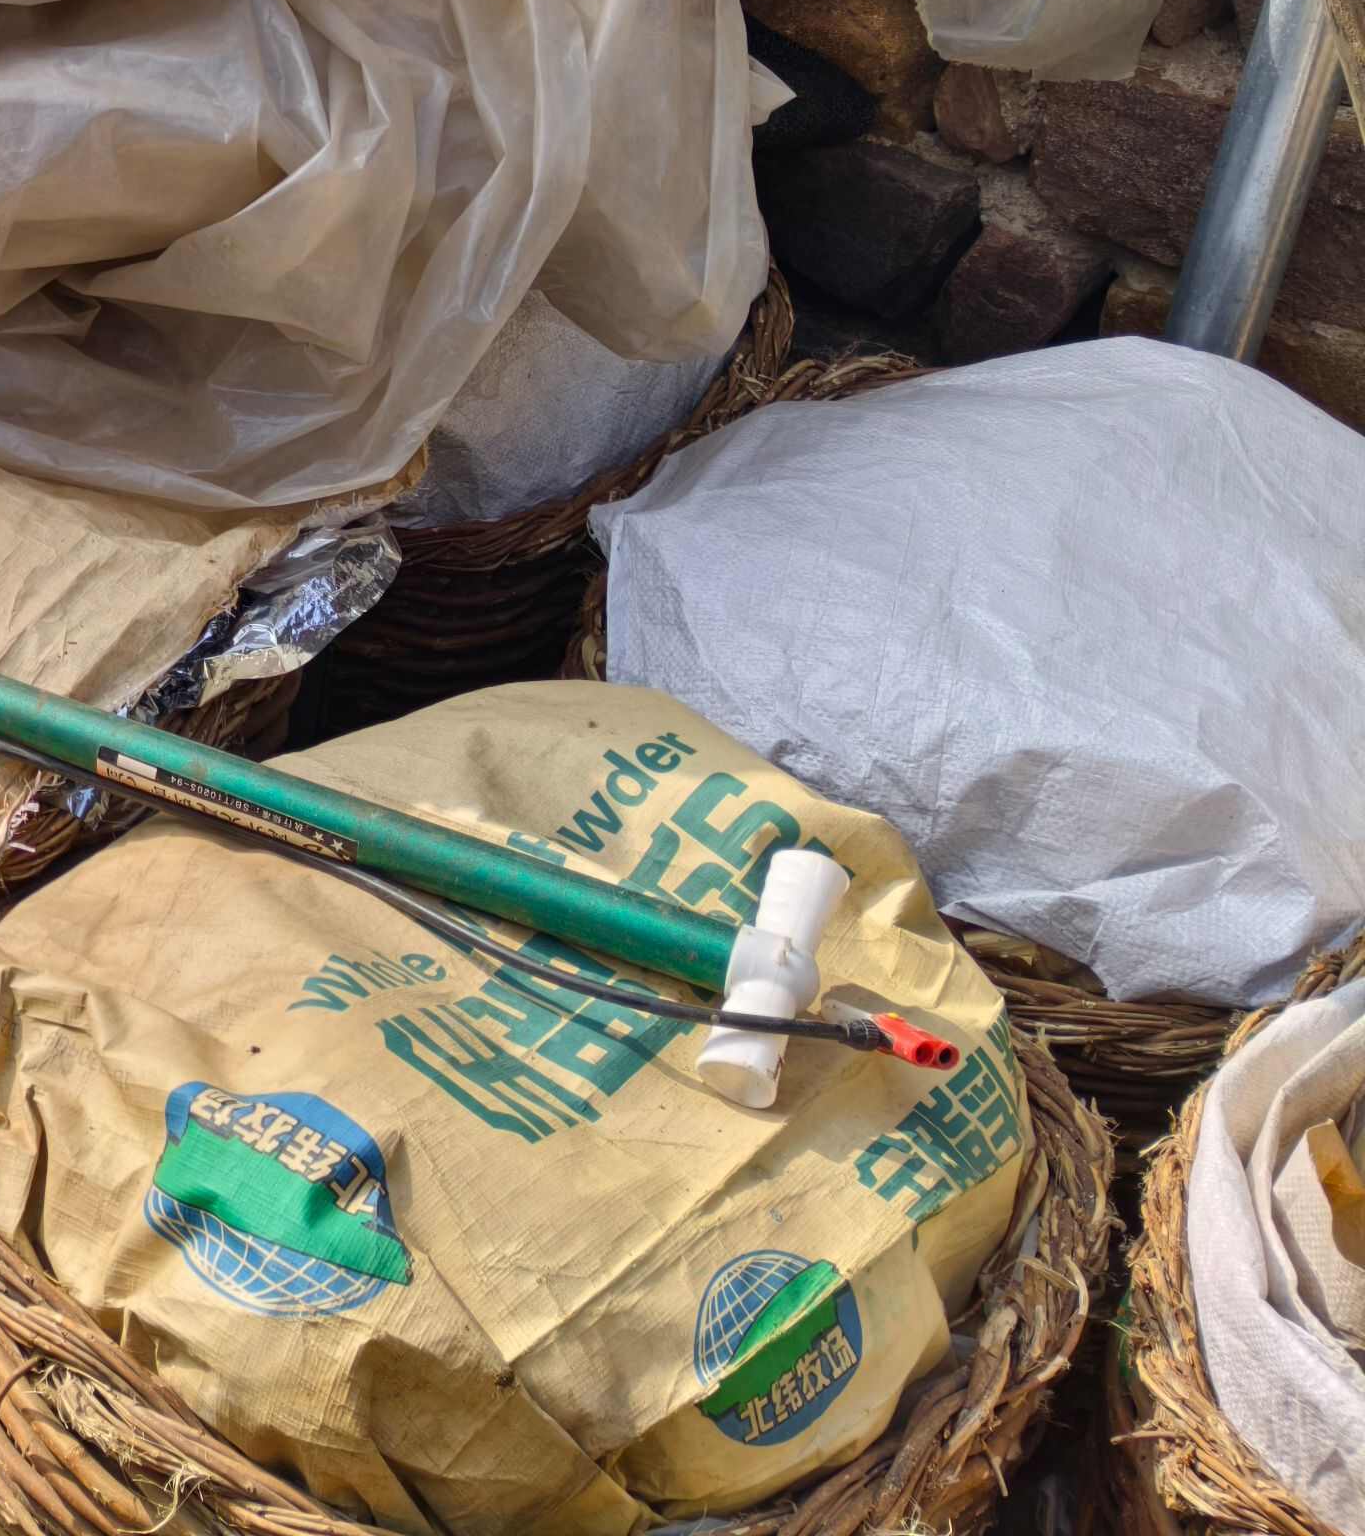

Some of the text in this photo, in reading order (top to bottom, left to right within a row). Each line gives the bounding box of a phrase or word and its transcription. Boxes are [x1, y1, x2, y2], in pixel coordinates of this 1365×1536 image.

[286, 945, 446, 1013] Whole
[189, 1088, 387, 1215] 北纬牧场
[738, 1326, 857, 1443] 北纬牧场
